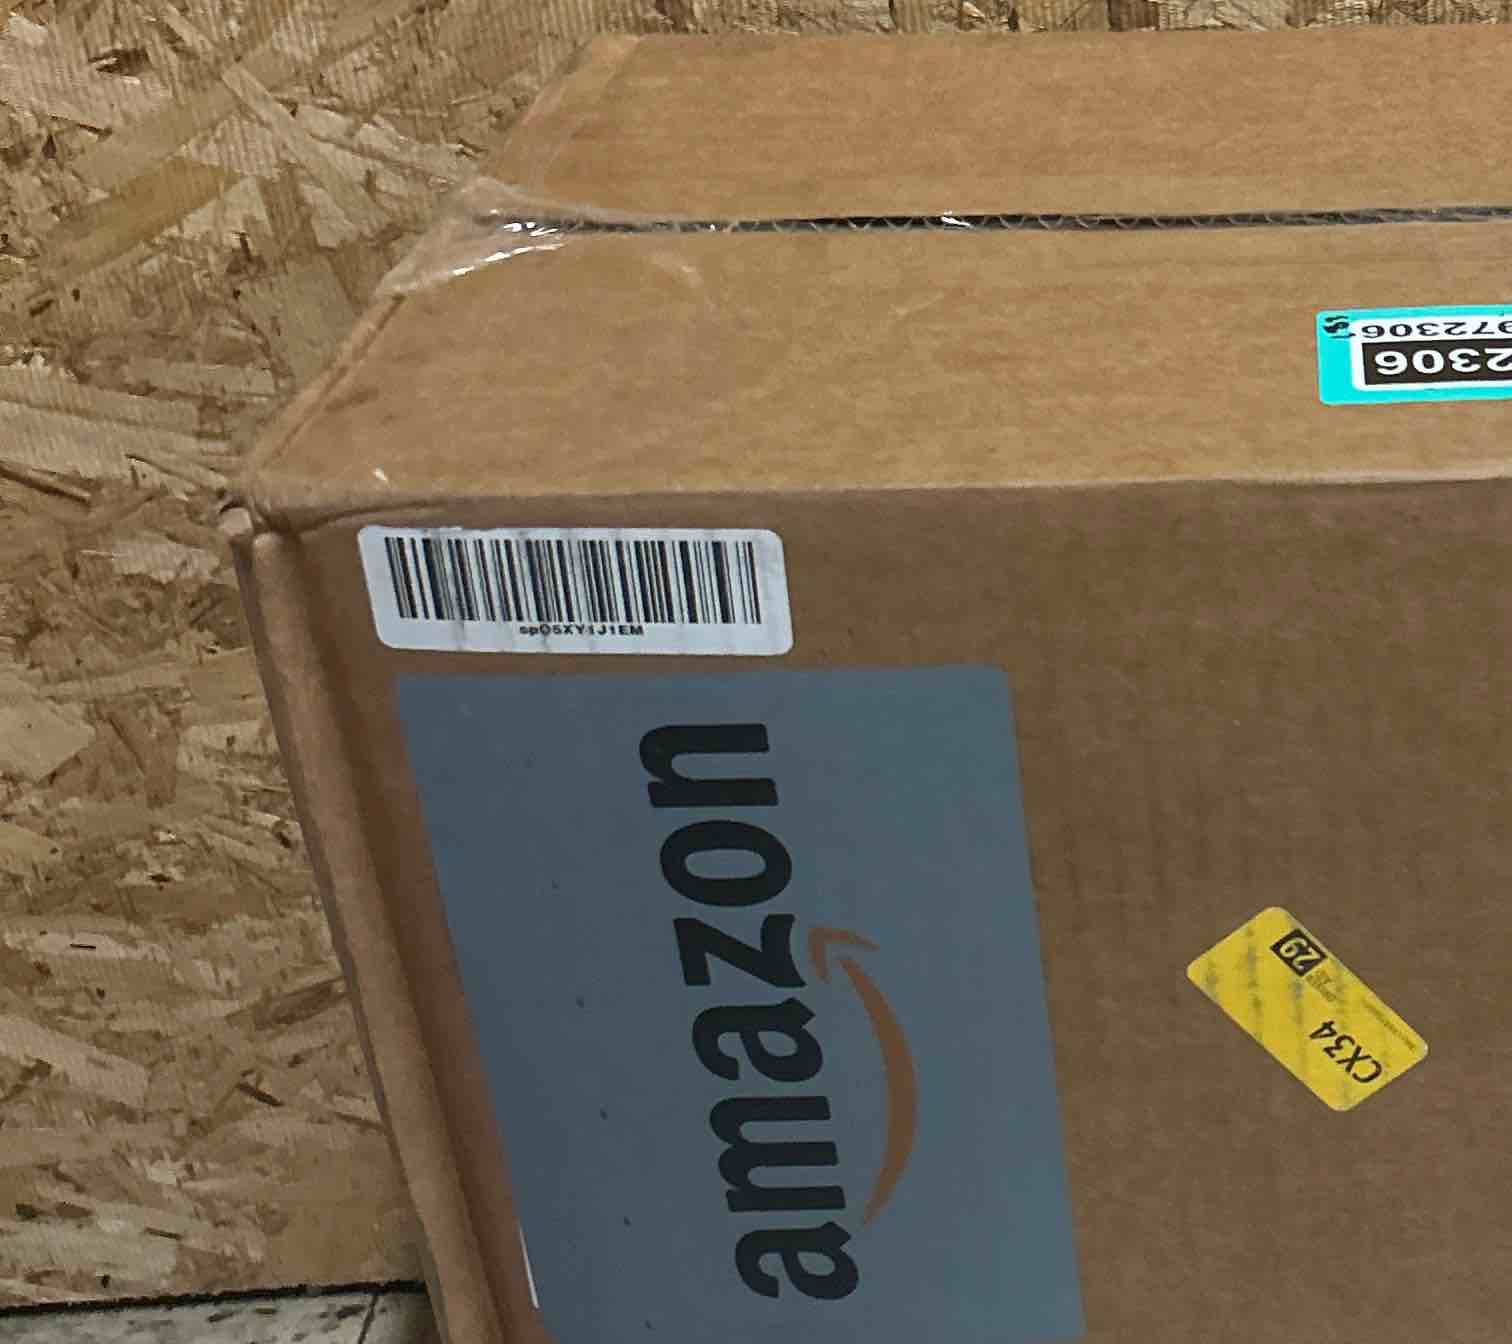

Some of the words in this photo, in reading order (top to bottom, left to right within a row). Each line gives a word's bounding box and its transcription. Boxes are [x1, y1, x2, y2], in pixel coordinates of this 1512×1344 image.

[1279, 936, 1321, 970] 29
[638, 722, 860, 1301] amazon
[1308, 1020, 1383, 1083] CX34
